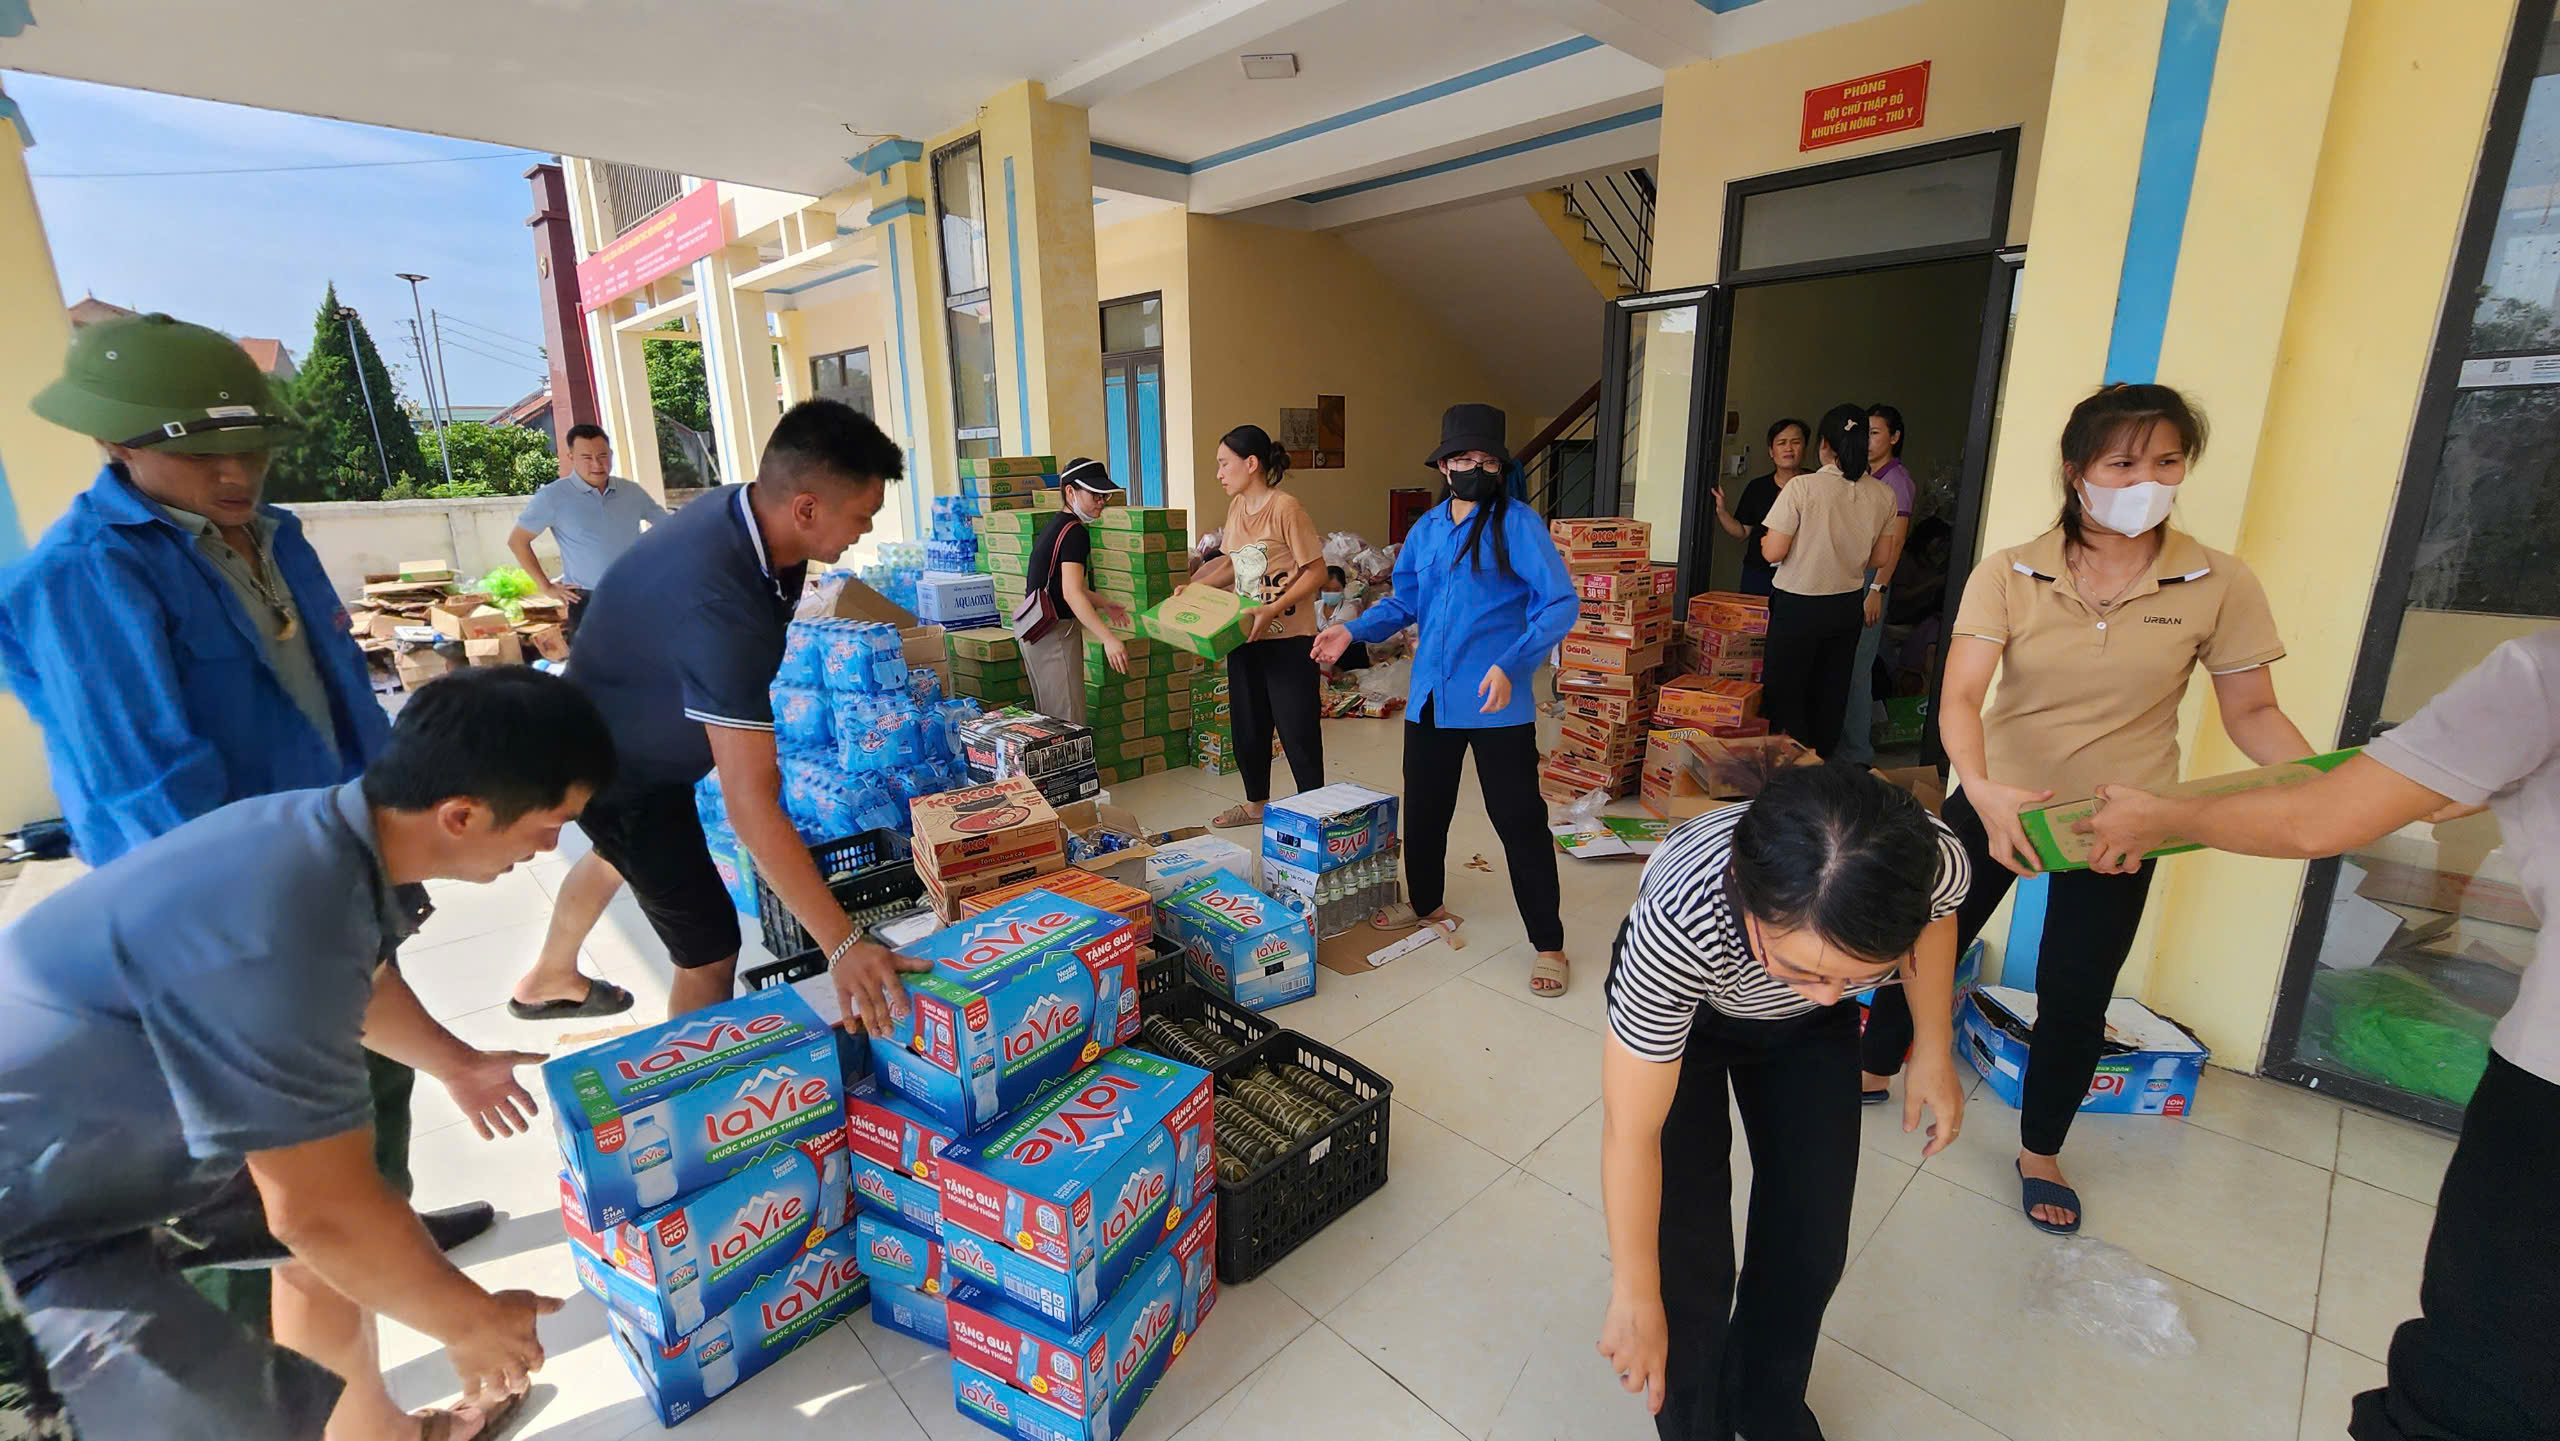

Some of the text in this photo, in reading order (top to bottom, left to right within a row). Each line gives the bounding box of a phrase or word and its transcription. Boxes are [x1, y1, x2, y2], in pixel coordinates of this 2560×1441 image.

[1843, 79, 1886, 99] PHÒNG
[1823, 89, 1904, 122] HỘI CHỮ THẬP ĐỎ
[1811, 120, 1848, 139] KHUYẾN
[1849, 115, 1877, 131] NÔNG
[1885, 108, 1904, 123] THÚ
[1906, 106, 1914, 118] Y
[1583, 531, 1627, 542] KOKOMI
[954, 594, 994, 609] AQUAOXYA
[1587, 588, 1596, 597] 30
[2144, 616, 2182, 624] URBAN
[926, 780, 1023, 809] KOKOMI
[952, 836, 1000, 854] KOKOMI
[1201, 889, 1262, 926] laVie
[937, 911, 1073, 971] laVie
[1001, 944, 1039, 966] KHOÁNG
[1085, 929, 1132, 962] TẶNG QUÀ
[1256, 939, 1288, 958] laVie
[970, 1014, 987, 1029] MỚI
[1003, 1004, 1080, 1062] laVie
[616, 1014, 785, 1080] laVie
[1006, 1062, 1023, 1076] NƯỚC
[1024, 1047, 1048, 1066] KHOÁNG
[1074, 1068, 1097, 1086] NƯỚC
[705, 1077, 828, 1143] laVie
[1044, 1085, 1075, 1112] KHOÁNG
[1171, 1085, 1209, 1127] TẶNG QUÀ
[712, 1104, 833, 1161] NƯỚC KHOÁNG THIÊN NHIÊN
[850, 1114, 899, 1144] TẶNG QUÀ
[1011, 1075, 1140, 1165] laVie
[1015, 1111, 1043, 1133] THIÊN
[599, 1133, 622, 1149] MỚI
[988, 1132, 1017, 1155] NHIÊN
[635, 1148, 665, 1166] laVie
[856, 1173, 895, 1202] laVie
[944, 1178, 1001, 1211] TẶNG QUÀ
[603, 1208, 625, 1221] CHAI
[1102, 1173, 1164, 1247] laVie
[664, 1228, 686, 1245] MỚI
[709, 1197, 801, 1267] laVie
[765, 1231, 785, 1247] THIÊN
[1179, 1228, 1197, 1253] TẶNG
[871, 1239, 912, 1266] laVie
[949, 1239, 998, 1279] laVie
[669, 1265, 695, 1285] laVie
[760, 1255, 862, 1331] laVie
[766, 1329, 789, 1345] NƯỚC
[791, 1307, 823, 1331] KHOÁNG
[824, 1293, 846, 1309] THIÊN
[701, 1340, 728, 1360] laVie
[953, 1320, 1013, 1355] TẶNG QUÀ
[955, 1334, 977, 1348] TRONG
[1115, 1303, 1170, 1385] laVie
[960, 1382, 1009, 1417] laVie
